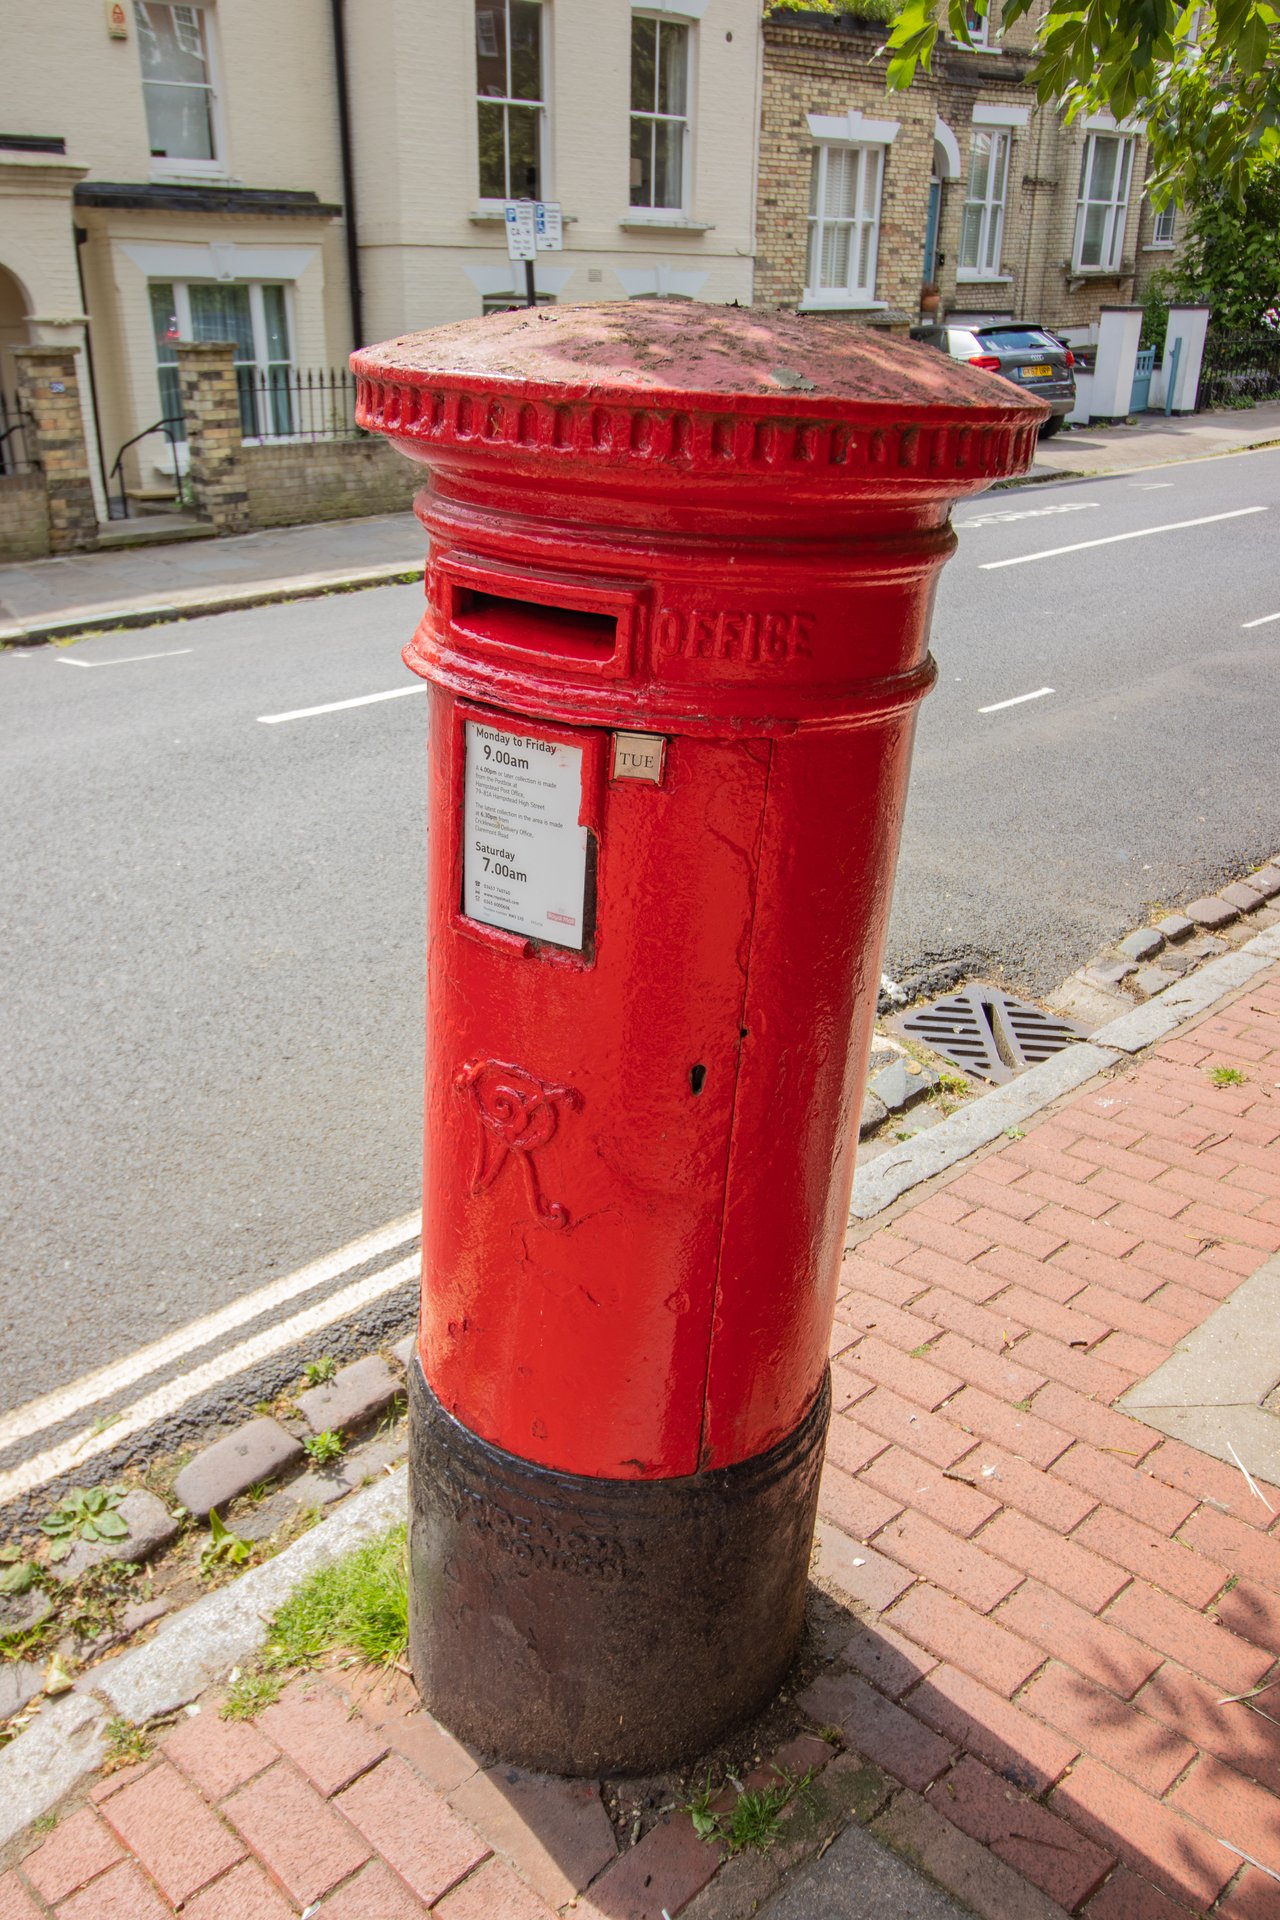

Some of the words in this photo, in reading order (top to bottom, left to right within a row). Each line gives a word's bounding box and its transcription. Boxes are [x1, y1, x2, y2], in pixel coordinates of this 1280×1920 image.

[657, 608, 815, 662] OFFICE
[476, 727, 510, 746] Monday
[513, 736, 522, 747] to
[526, 738, 557, 755] Friday
[484, 745, 529, 769] 9.00am
[620, 752, 654, 768] TUE
[476, 780, 499, 792] Hampstead
[515, 775, 536, 784] collection
[493, 792, 518, 804] Hampstead
[519, 799, 529, 807] High
[530, 802, 544, 810] Street
[497, 808, 517, 818] collection
[475, 842, 515, 862] Saturday
[482, 857, 527, 882] 7.00am
